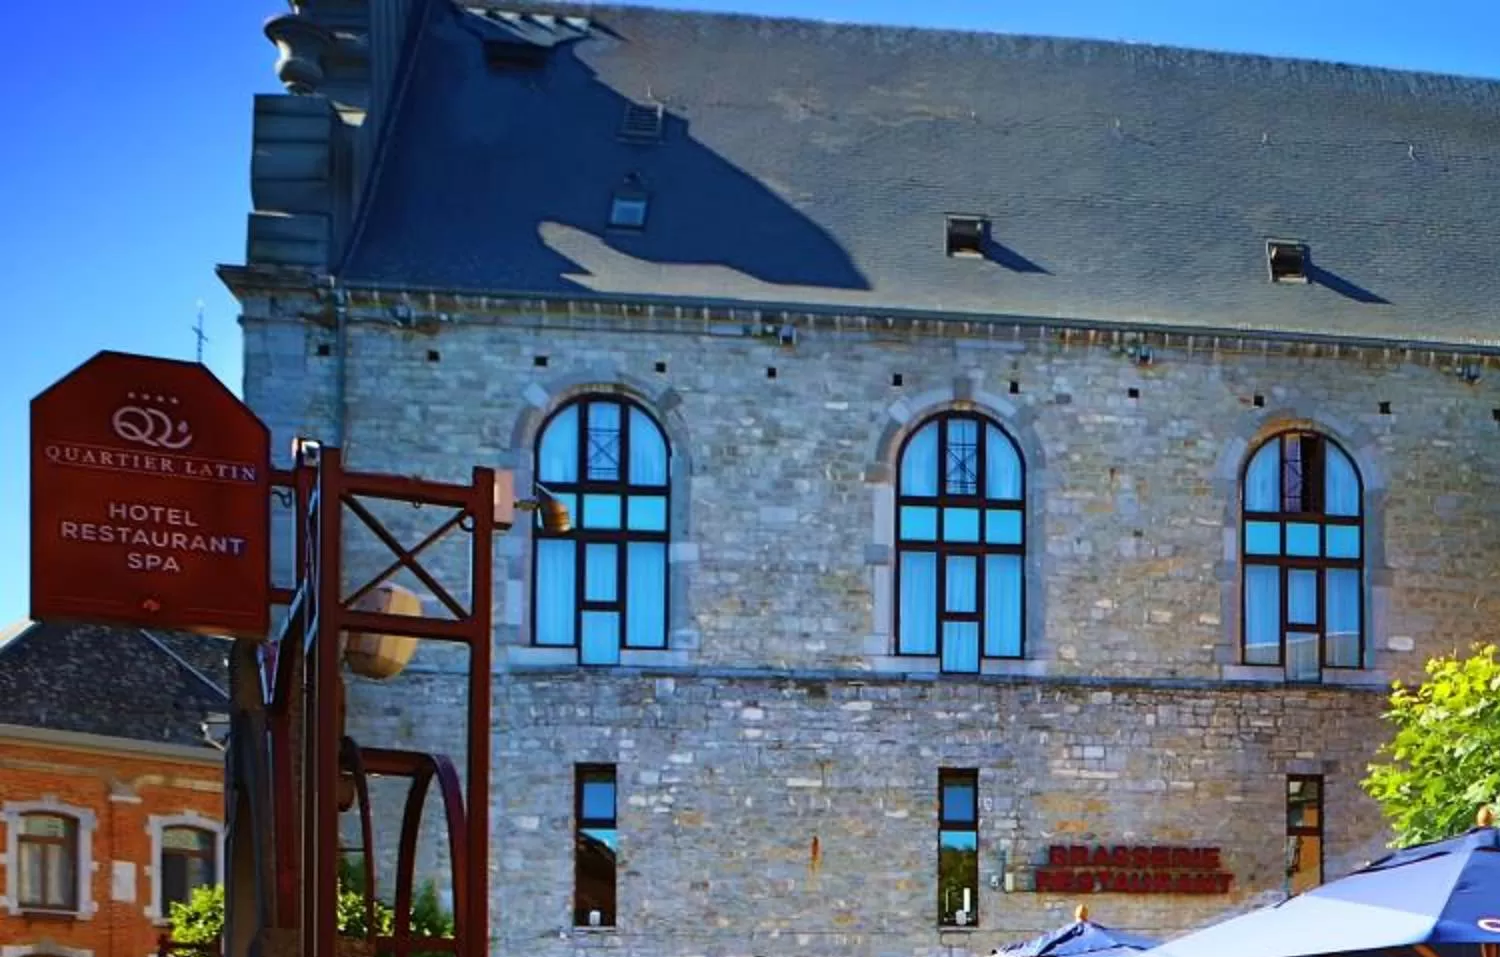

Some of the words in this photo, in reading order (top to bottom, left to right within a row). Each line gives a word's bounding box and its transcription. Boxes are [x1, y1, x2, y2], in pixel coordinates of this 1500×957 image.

[45, 445, 176, 473] QUARTIER
[185, 461, 256, 481] LATIN
[109, 502, 199, 527] HOTEL
[60, 521, 246, 555] RESTAURANT
[127, 553, 181, 573] SPA
